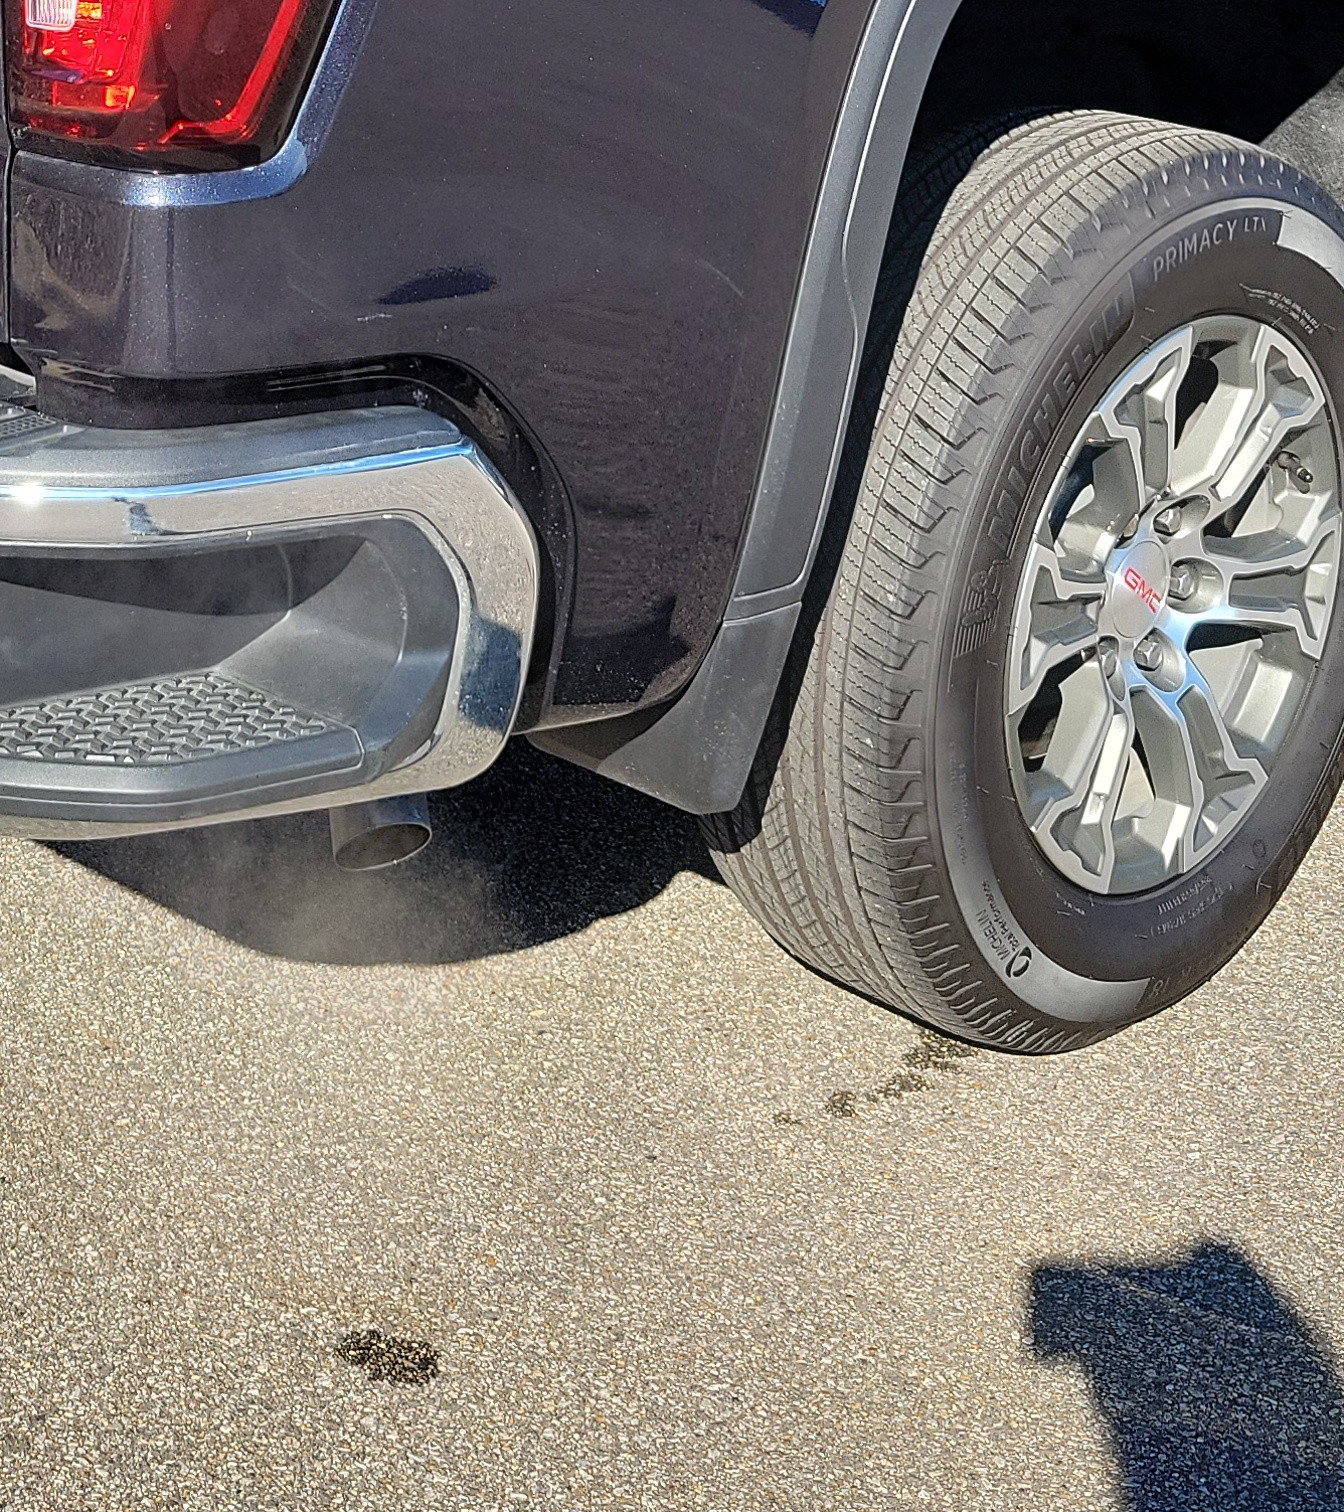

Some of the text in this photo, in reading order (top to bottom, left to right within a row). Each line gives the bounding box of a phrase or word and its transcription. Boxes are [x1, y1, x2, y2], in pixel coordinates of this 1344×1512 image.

[1153, 219, 1237, 282] PRIMACY
[987, 292, 1126, 551] MICHELIN
[1123, 567, 1162, 614] GMC
[976, 908, 1011, 961] MICHELIN
[1005, 931, 1021, 952] Total
